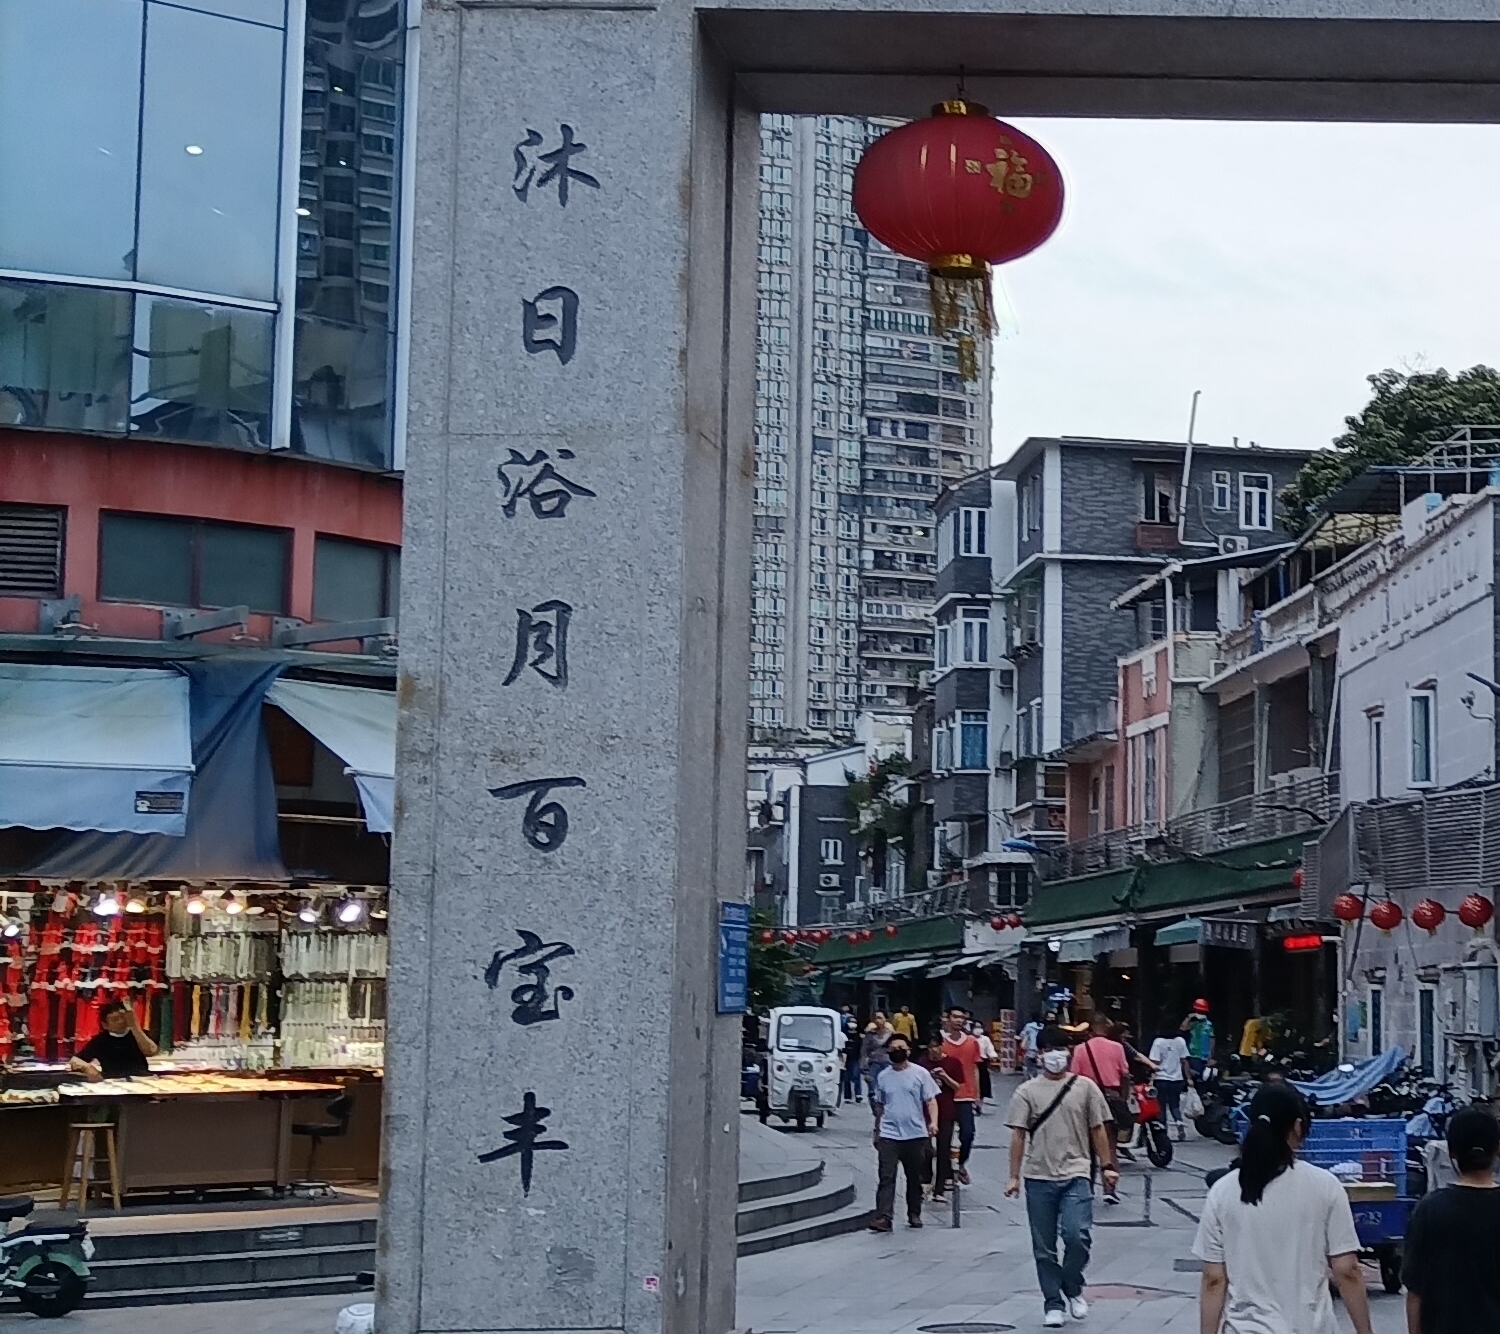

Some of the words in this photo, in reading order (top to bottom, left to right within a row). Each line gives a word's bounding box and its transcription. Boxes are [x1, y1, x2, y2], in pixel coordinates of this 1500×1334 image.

[478, 122, 600, 1198] 沐日浴月百宝丰
